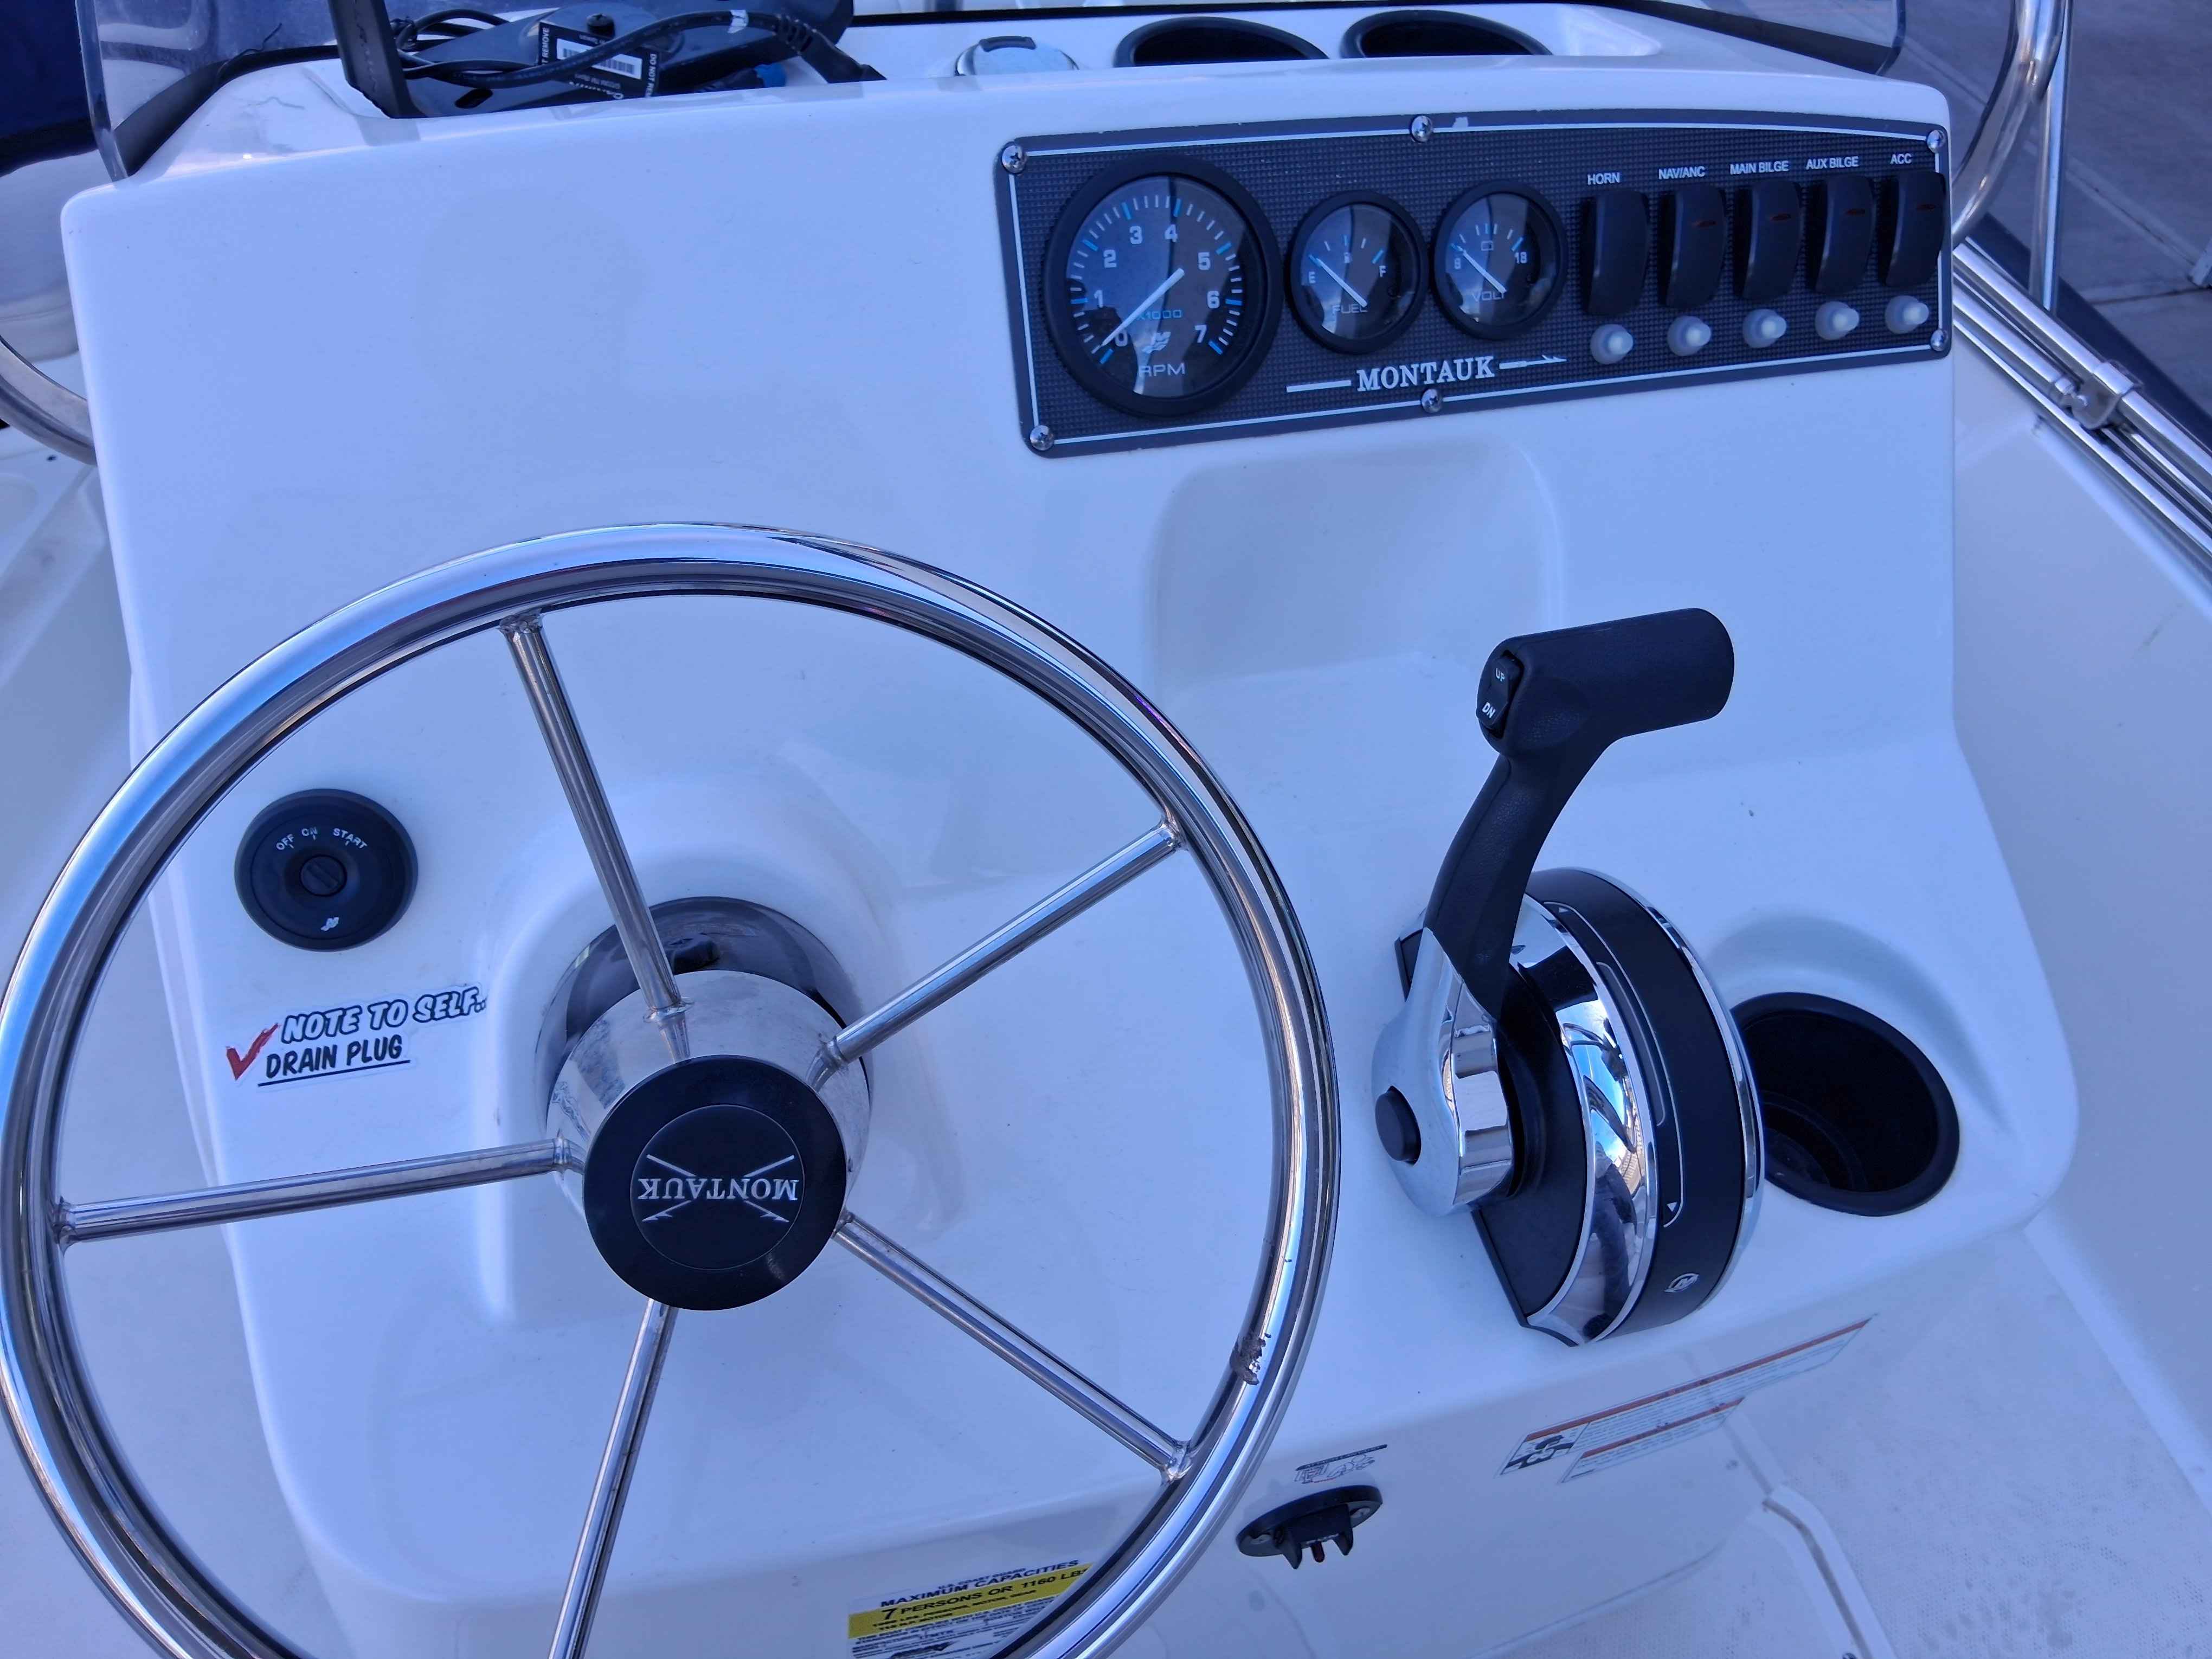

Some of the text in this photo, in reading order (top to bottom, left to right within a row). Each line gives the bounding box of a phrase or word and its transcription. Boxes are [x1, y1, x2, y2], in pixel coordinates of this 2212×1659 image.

[1806, 156, 1859, 170] AUX BILGE
[1890, 153, 1912, 164] ACC
[1658, 165, 1706, 179] NAV/ANC
[1729, 160, 1789, 175] MAIN BILGE
[1587, 172, 1620, 185] HORN
[1129, 226, 1143, 245] 3
[1165, 224, 1178, 242] 4
[1103, 249, 1117, 268] 2
[1198, 252, 1211, 271] 5
[1454, 257, 1461, 269] 8
[1514, 251, 1527, 264] 18
[1308, 271, 1316, 284] E
[1379, 265, 1386, 278] F
[1094, 290, 1104, 308] 1
[1206, 291, 1220, 308] 6
[1332, 303, 1368, 314] FUEL
[1114, 330, 1128, 347] 0
[1194, 324, 1207, 343] 7
[1139, 362, 1186, 378] RPM
[1356, 356, 1495, 391] MONTAUK
[1482, 702, 1496, 718] DN
[276, 827, 368, 850] OFF ON START
[281, 1005, 363, 1044] NOTE
[368, 999, 409, 1030] TO
[266, 1034, 403, 1079] DRAIN PLUG
[637, 1177, 800, 1201] MONTAUK
[880, 1584, 969, 1607] MAXIMUM
[974, 1560, 1079, 1587] CAPACITIES
[882, 1607, 897, 1620] 7
[900, 1592, 983, 1615] PERSONS
[988, 1585, 1013, 1596] OR
[1021, 1576, 1056, 1588] 1160
